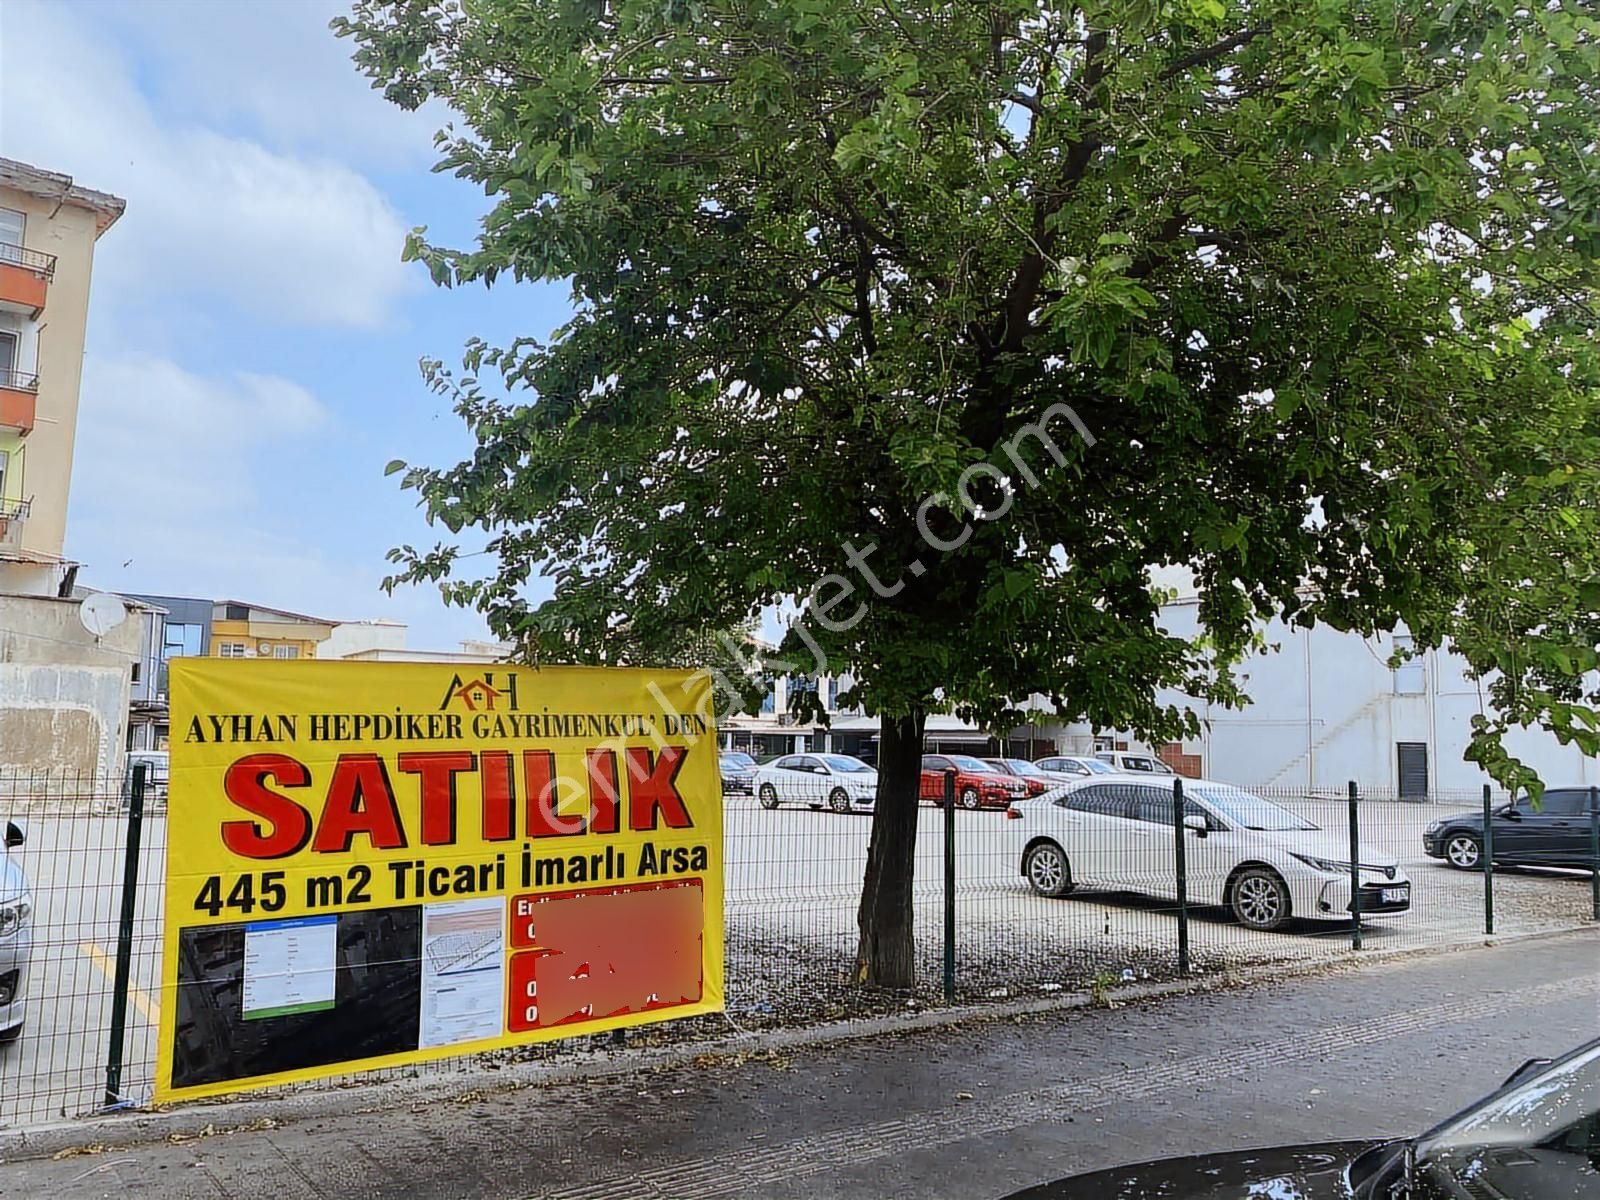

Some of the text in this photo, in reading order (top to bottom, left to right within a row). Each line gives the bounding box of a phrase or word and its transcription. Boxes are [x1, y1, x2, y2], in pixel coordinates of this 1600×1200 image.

[184, 713, 298, 743] AYHAN
[308, 706, 464, 741] HEPDİKER
[662, 713, 708, 736] DEN
[220, 746, 695, 860] SATILIK
[194, 871, 287, 917] 445
[306, 864, 372, 908] m2
[388, 853, 506, 900] Ticari
[521, 843, 626, 888] İmarlı
[637, 842, 708, 877] Arsa
